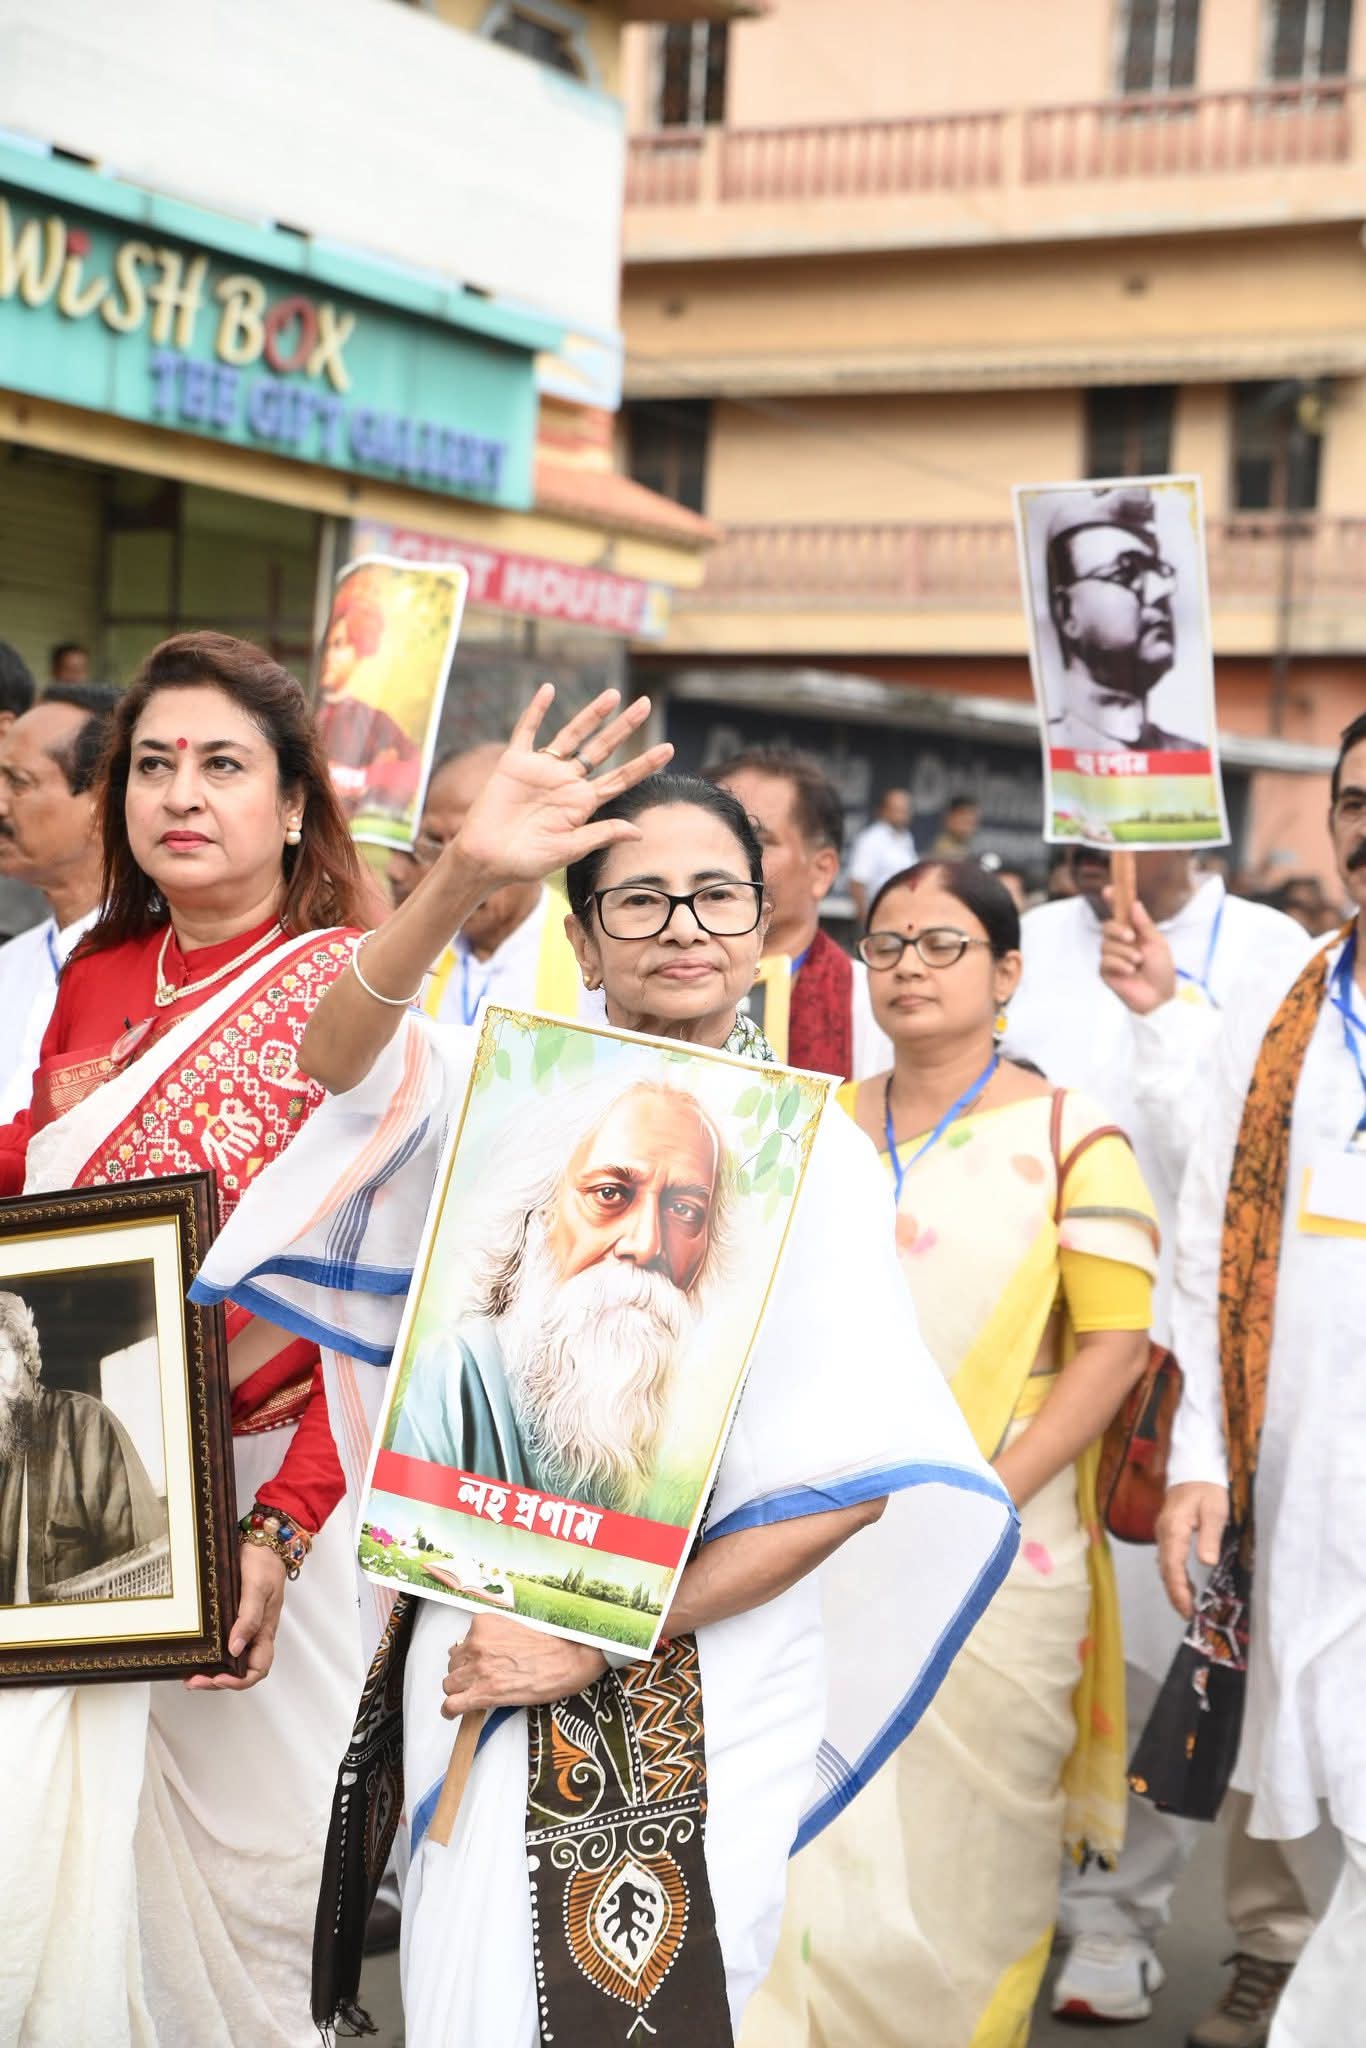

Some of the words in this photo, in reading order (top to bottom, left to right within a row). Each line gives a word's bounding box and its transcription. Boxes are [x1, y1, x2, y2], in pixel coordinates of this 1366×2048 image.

[214, 273, 356, 393] BOX
[150, 349, 238, 426] THE
[247, 376, 344, 458] GIFT
[349, 406, 506, 489] GALLERY
[457, 1476, 512, 1524] লহ
[512, 1491, 604, 1547] প্রণাম
